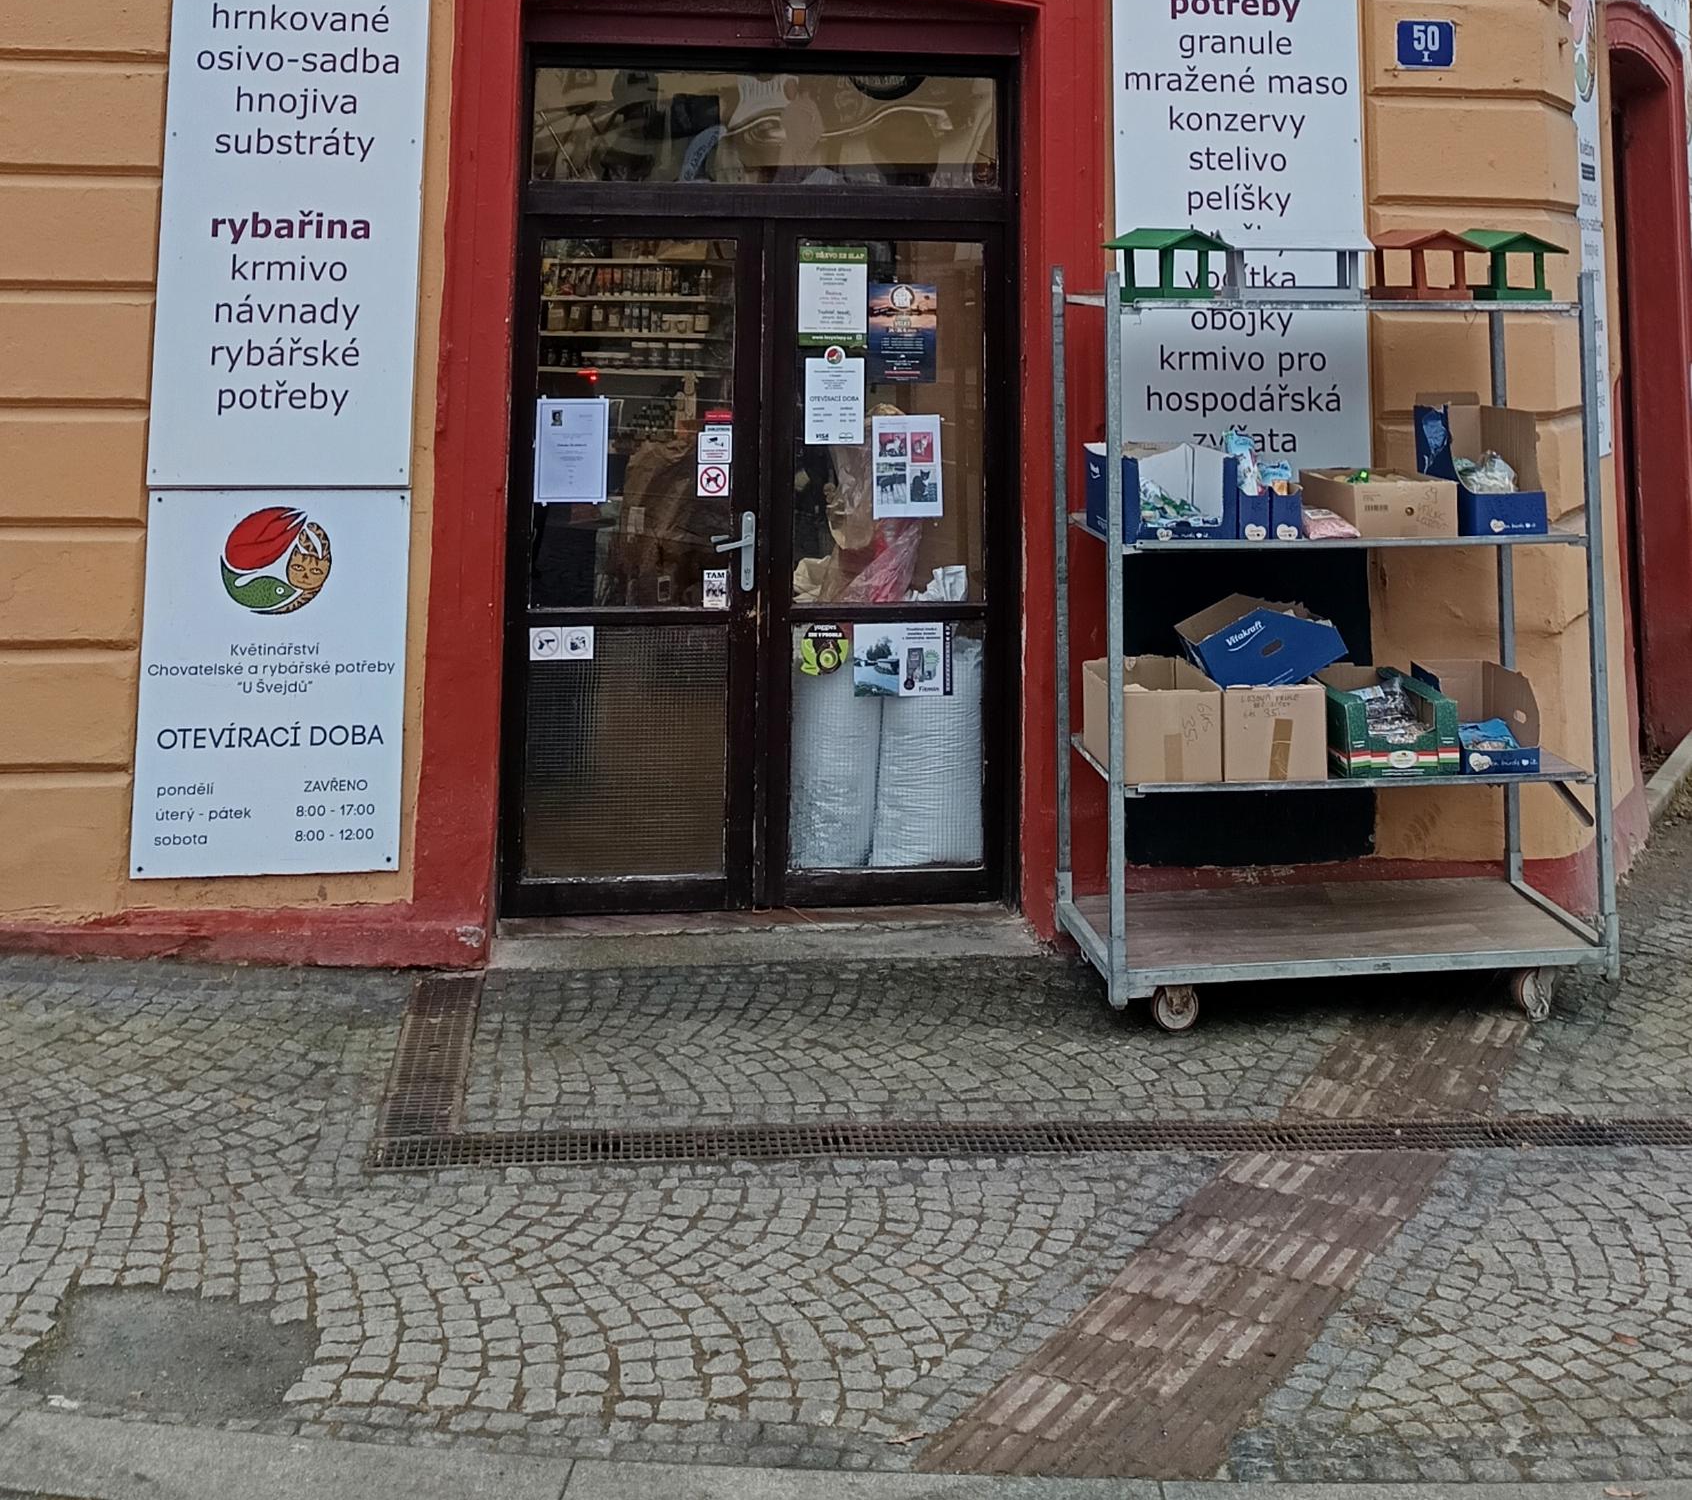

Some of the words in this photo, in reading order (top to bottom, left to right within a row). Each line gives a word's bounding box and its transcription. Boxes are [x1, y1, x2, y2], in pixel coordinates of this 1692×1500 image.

[213, 3, 388, 32] hrnkované
[1180, 31, 1291, 58] granule
[1413, 25, 1440, 51] 50
[197, 46, 399, 73] osivo-sadba
[1126, 66, 1254, 93] mražené
[1269, 76, 1347, 95] maso
[237, 86, 356, 119] hnojiva
[1170, 106, 1305, 138] konzervy
[216, 128, 374, 162] substráty
[1190, 146, 1286, 171] stelivo
[1188, 184, 1291, 217] pelíšky
[212, 210, 369, 244] rybařina
[232, 254, 347, 281] krmivo
[216, 295, 359, 330] návnady
[1191, 311, 1293, 337] obojky
[212, 337, 359, 372] rybářské
[1161, 345, 1264, 371] krmivo
[1279, 353, 1326, 377] pro
[218, 380, 348, 416] potřeby
[1147, 384, 1340, 416] hospodářská
[1225, 620, 1263, 647] Vitakraft
[231, 643, 319, 656] Květinářství
[148, 663, 243, 676] Chovatelské
[248, 665, 258, 675] a
[262, 661, 330, 677] rybářské
[335, 661, 395, 675] potřeby
[157, 722, 301, 749] OTEVÍRACÍ
[310, 725, 383, 746] DOBA
[157, 783, 213, 798] pondělí
[304, 778, 367, 792] ZAVŘENO
[156, 808, 194, 822] úterý
[209, 807, 251, 821] pátek
[296, 805, 325, 817] 8:00
[341, 804, 374, 815] 17:00
[154, 834, 207, 846] sobota
[295, 830, 324, 841] 8:00
[340, 828, 373, 840] 12:00
